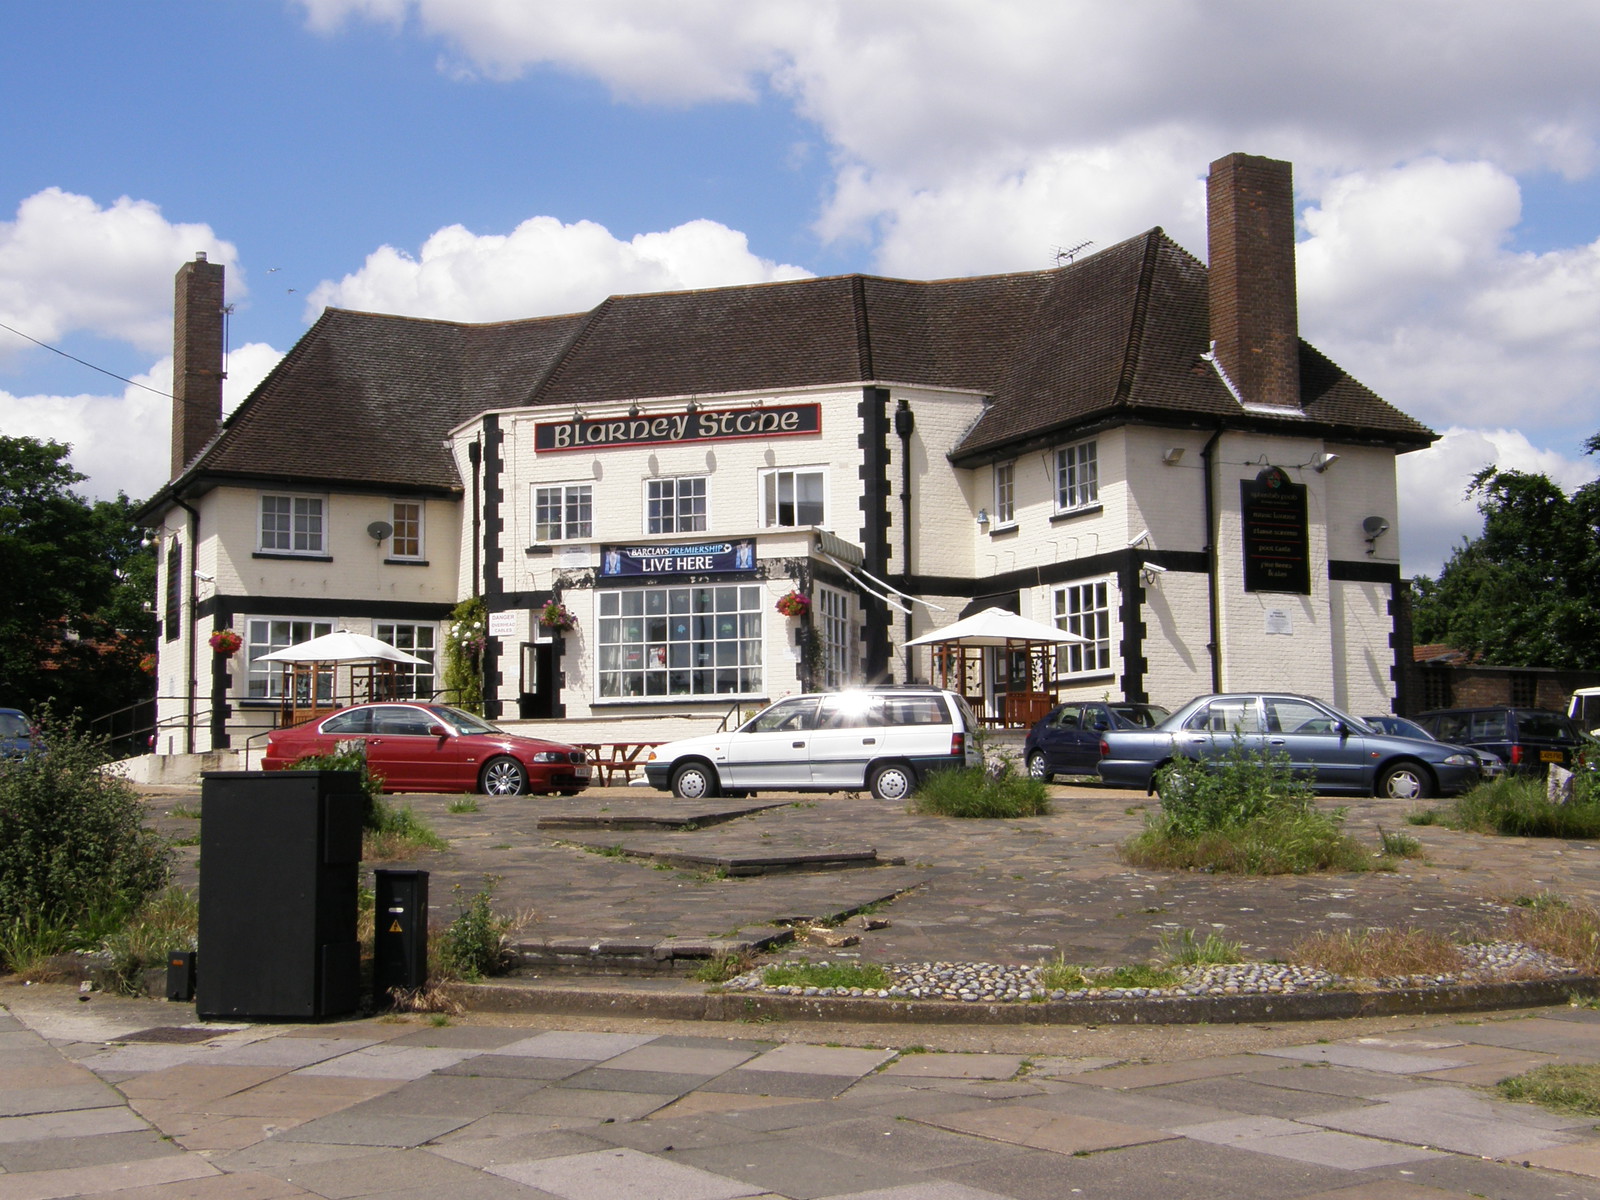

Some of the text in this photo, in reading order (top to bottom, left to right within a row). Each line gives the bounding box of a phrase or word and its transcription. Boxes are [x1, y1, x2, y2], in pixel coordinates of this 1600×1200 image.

[631, 544, 724, 556] BARCLAYS PREMIERSHIP
[642, 556, 714, 572] LIVE HERE
